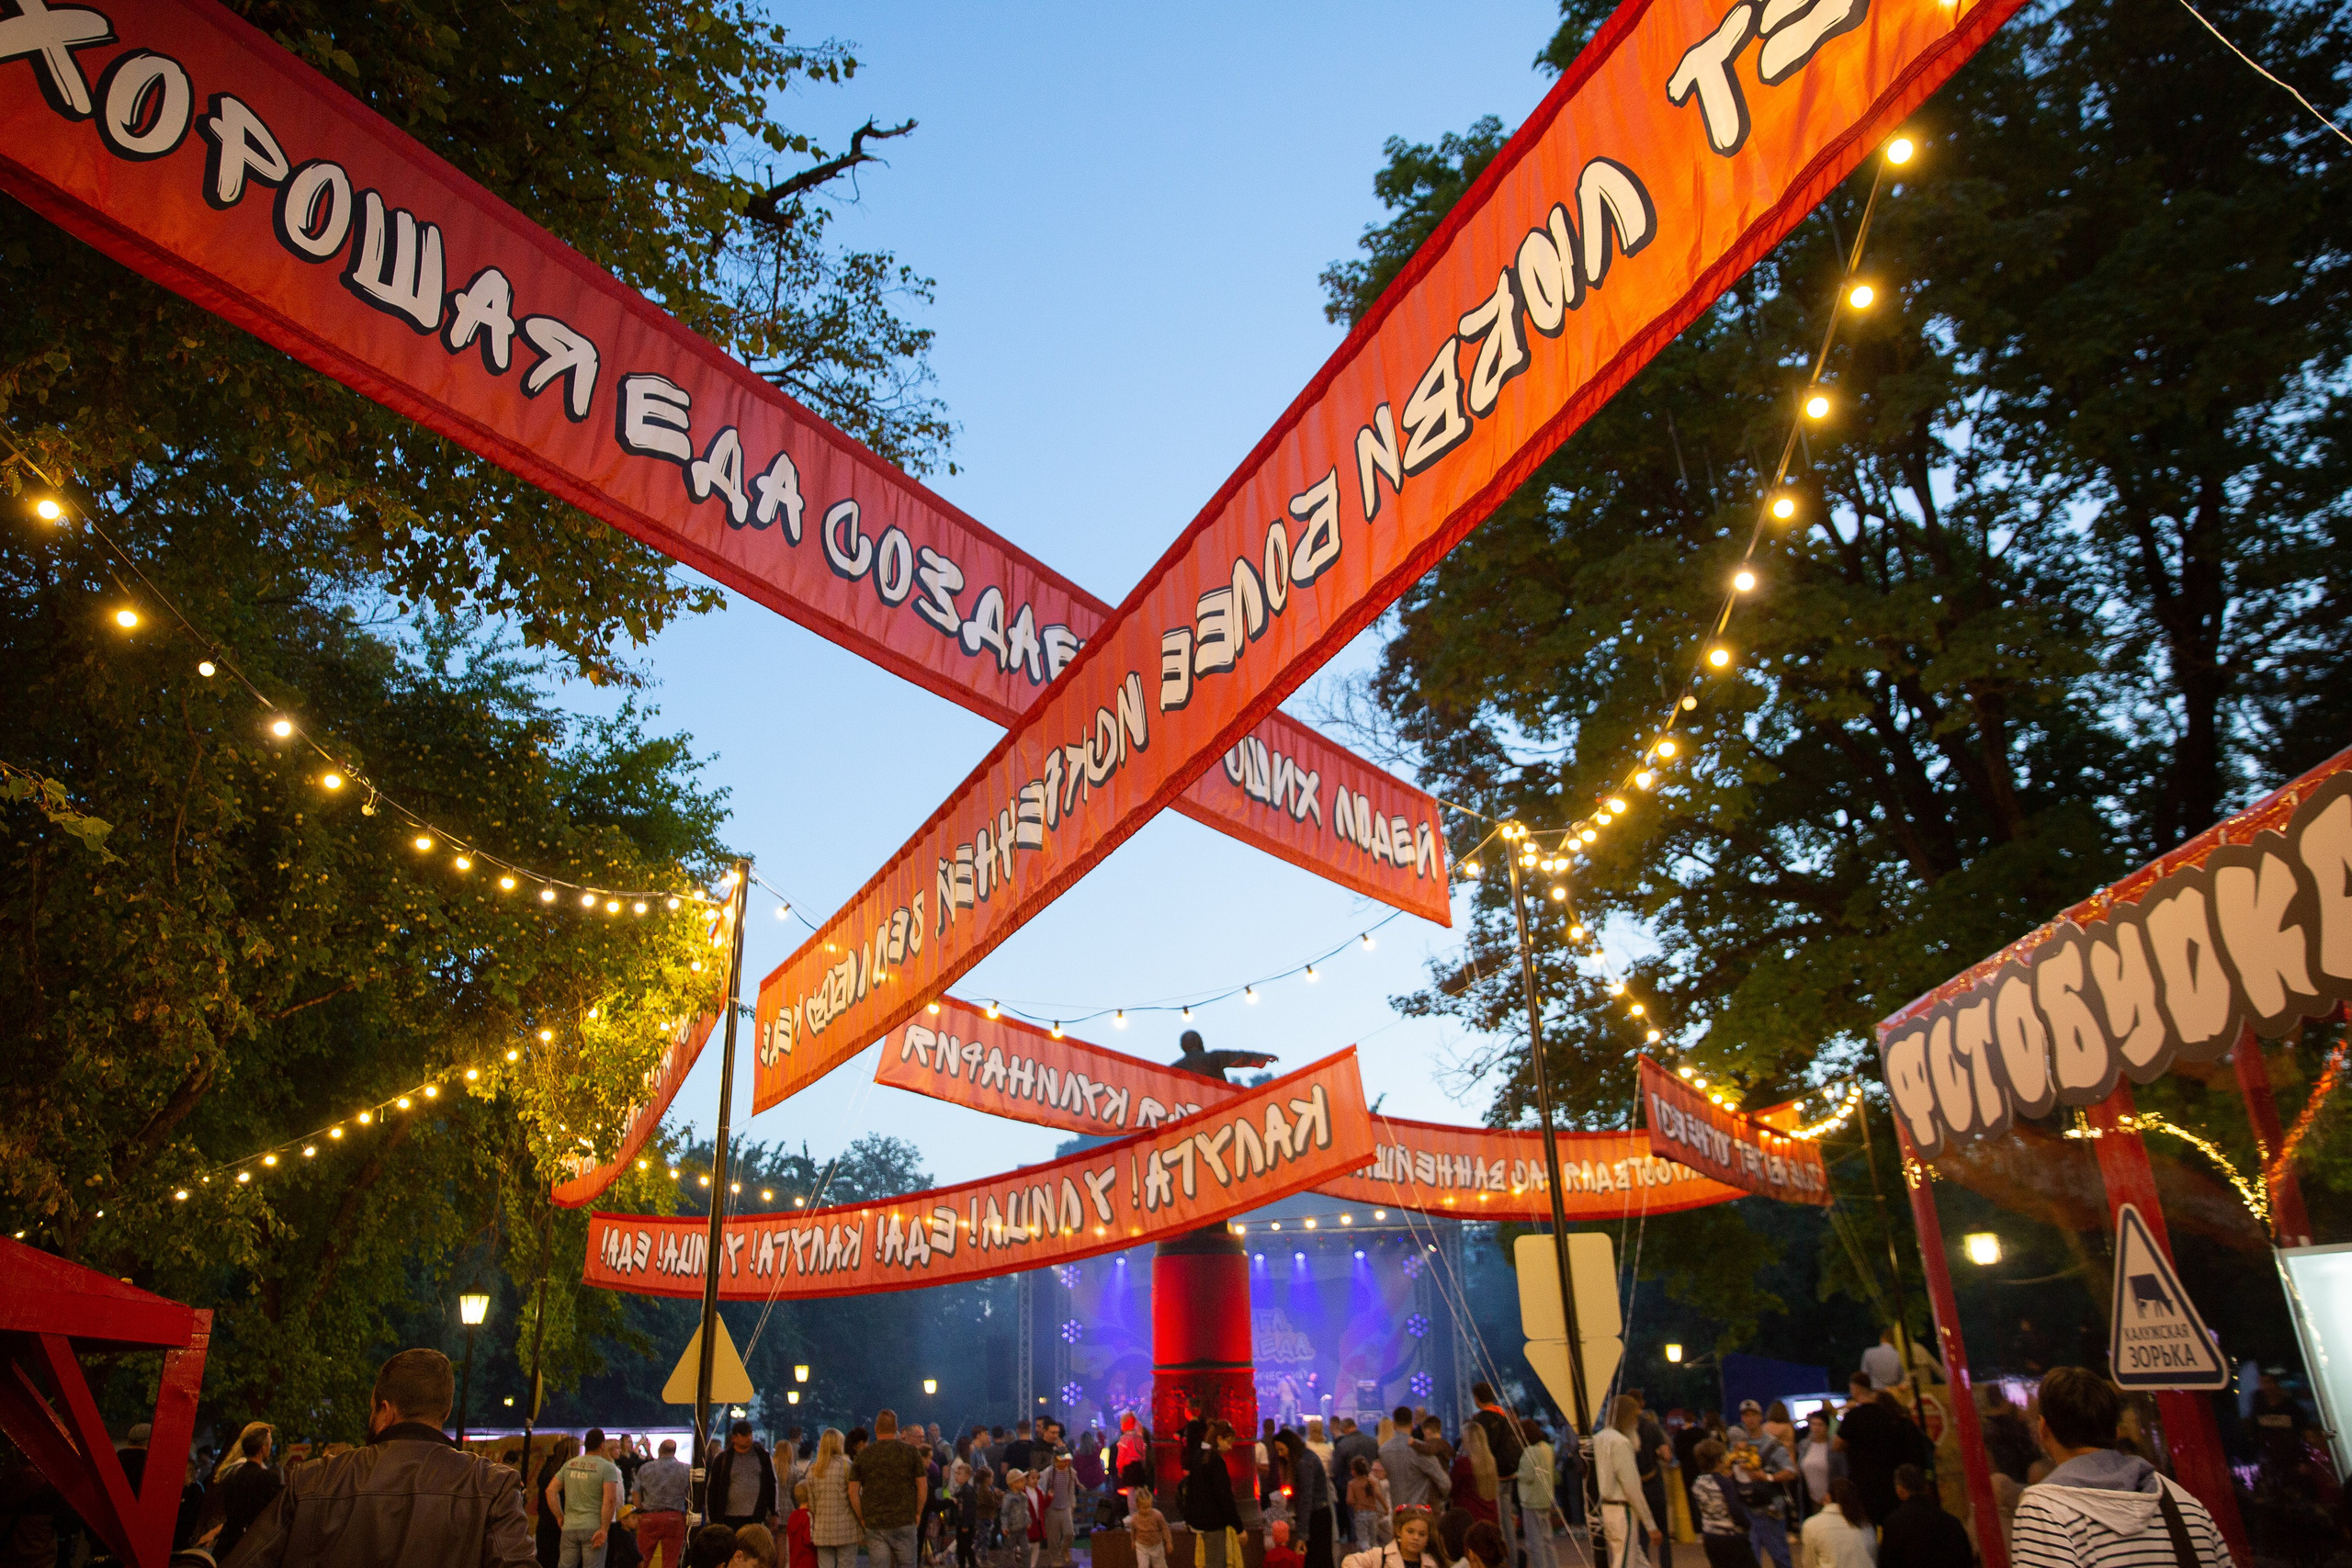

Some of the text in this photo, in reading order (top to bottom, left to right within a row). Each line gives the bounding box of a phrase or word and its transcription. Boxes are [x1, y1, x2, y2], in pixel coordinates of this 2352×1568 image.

[0, 0, 597, 422] ХОРОШАЯ
[616, 373, 804, 546] ЕДА
[821, 499, 1087, 685] СОЗДАЕ
[1333, 784, 1438, 883] ЛЮДЕЙ
[2128, 1343, 2199, 1369] ЗОРЬКА
